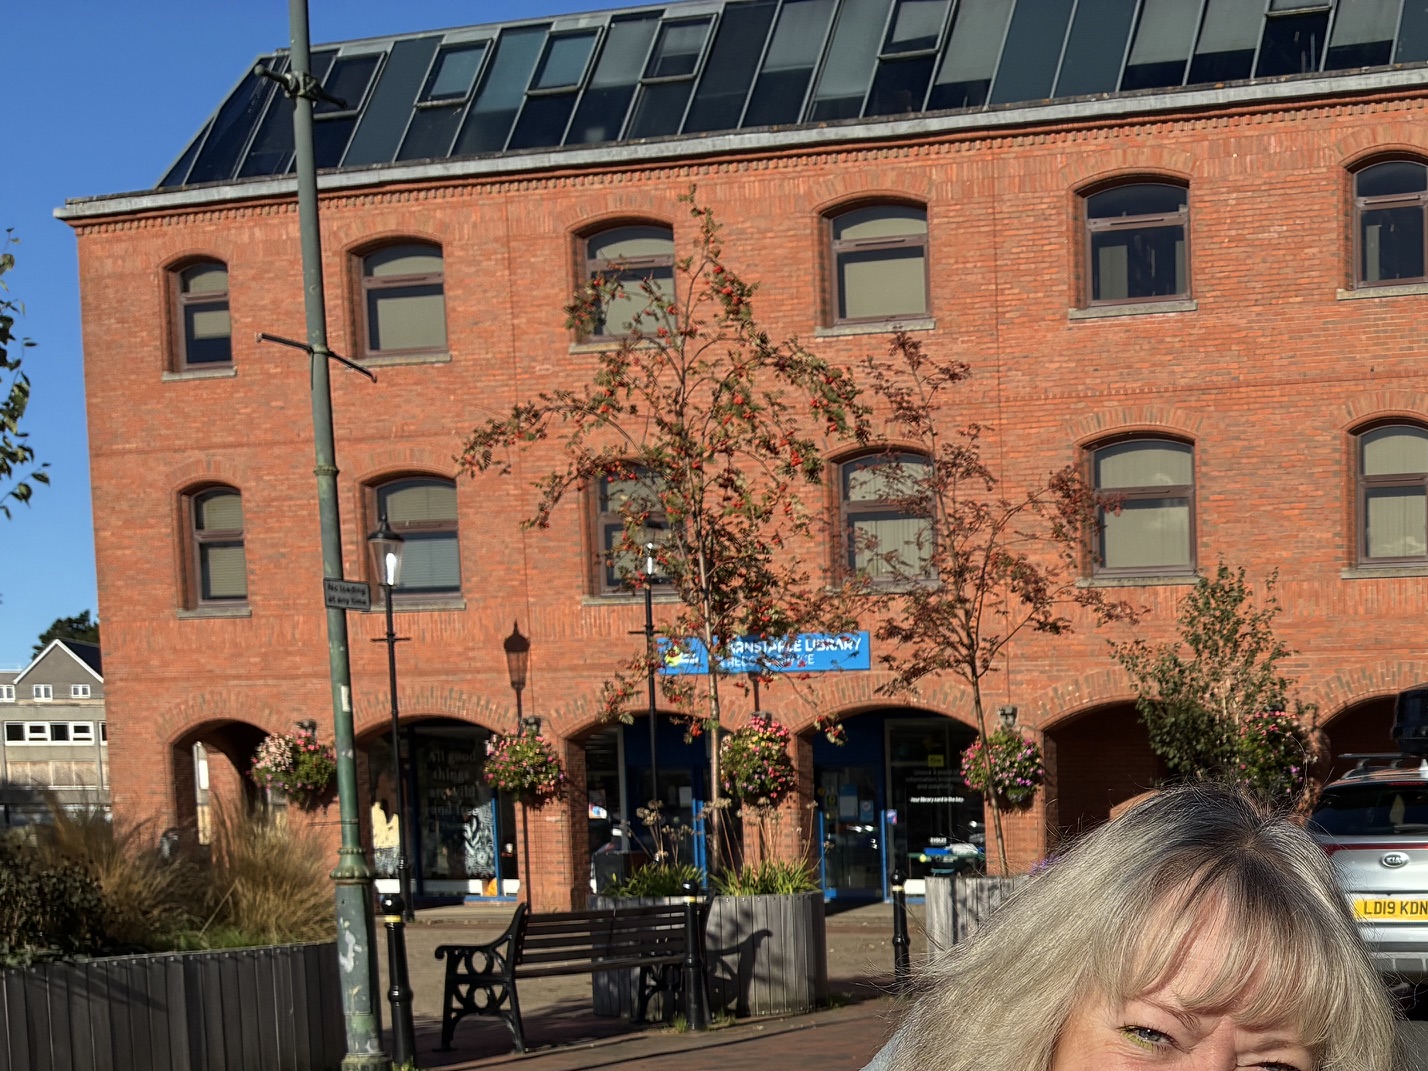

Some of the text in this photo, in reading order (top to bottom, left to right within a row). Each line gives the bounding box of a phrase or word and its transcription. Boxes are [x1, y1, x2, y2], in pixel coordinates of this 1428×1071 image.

[805, 637, 862, 652] LIBRARY
[1364, 901, 1428, 915] LD19 KDN
